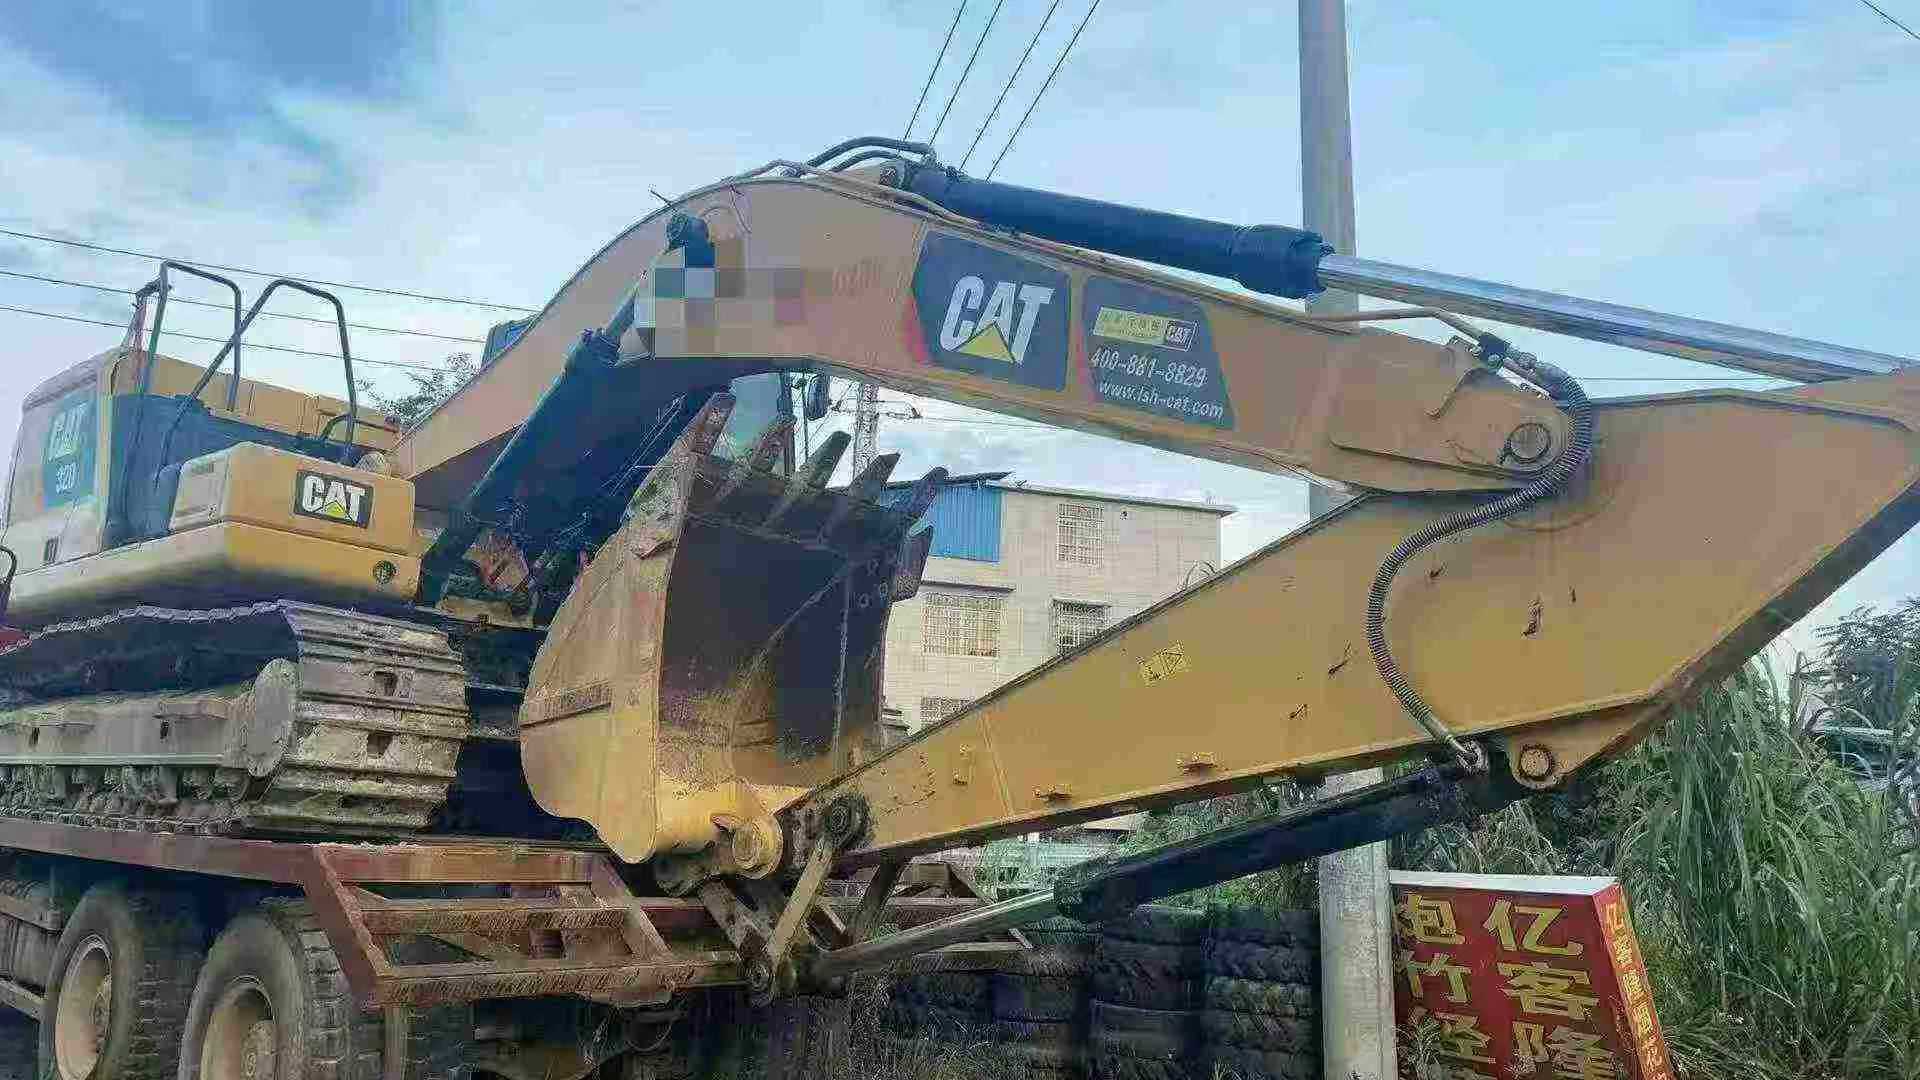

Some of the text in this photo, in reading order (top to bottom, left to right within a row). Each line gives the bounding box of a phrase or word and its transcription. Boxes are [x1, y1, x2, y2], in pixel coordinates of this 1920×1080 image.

[940, 275, 1055, 365] CAT
[1166, 324, 1192, 344] CAT
[48, 402, 87, 462] CAT
[302, 475, 366, 522] CAT
